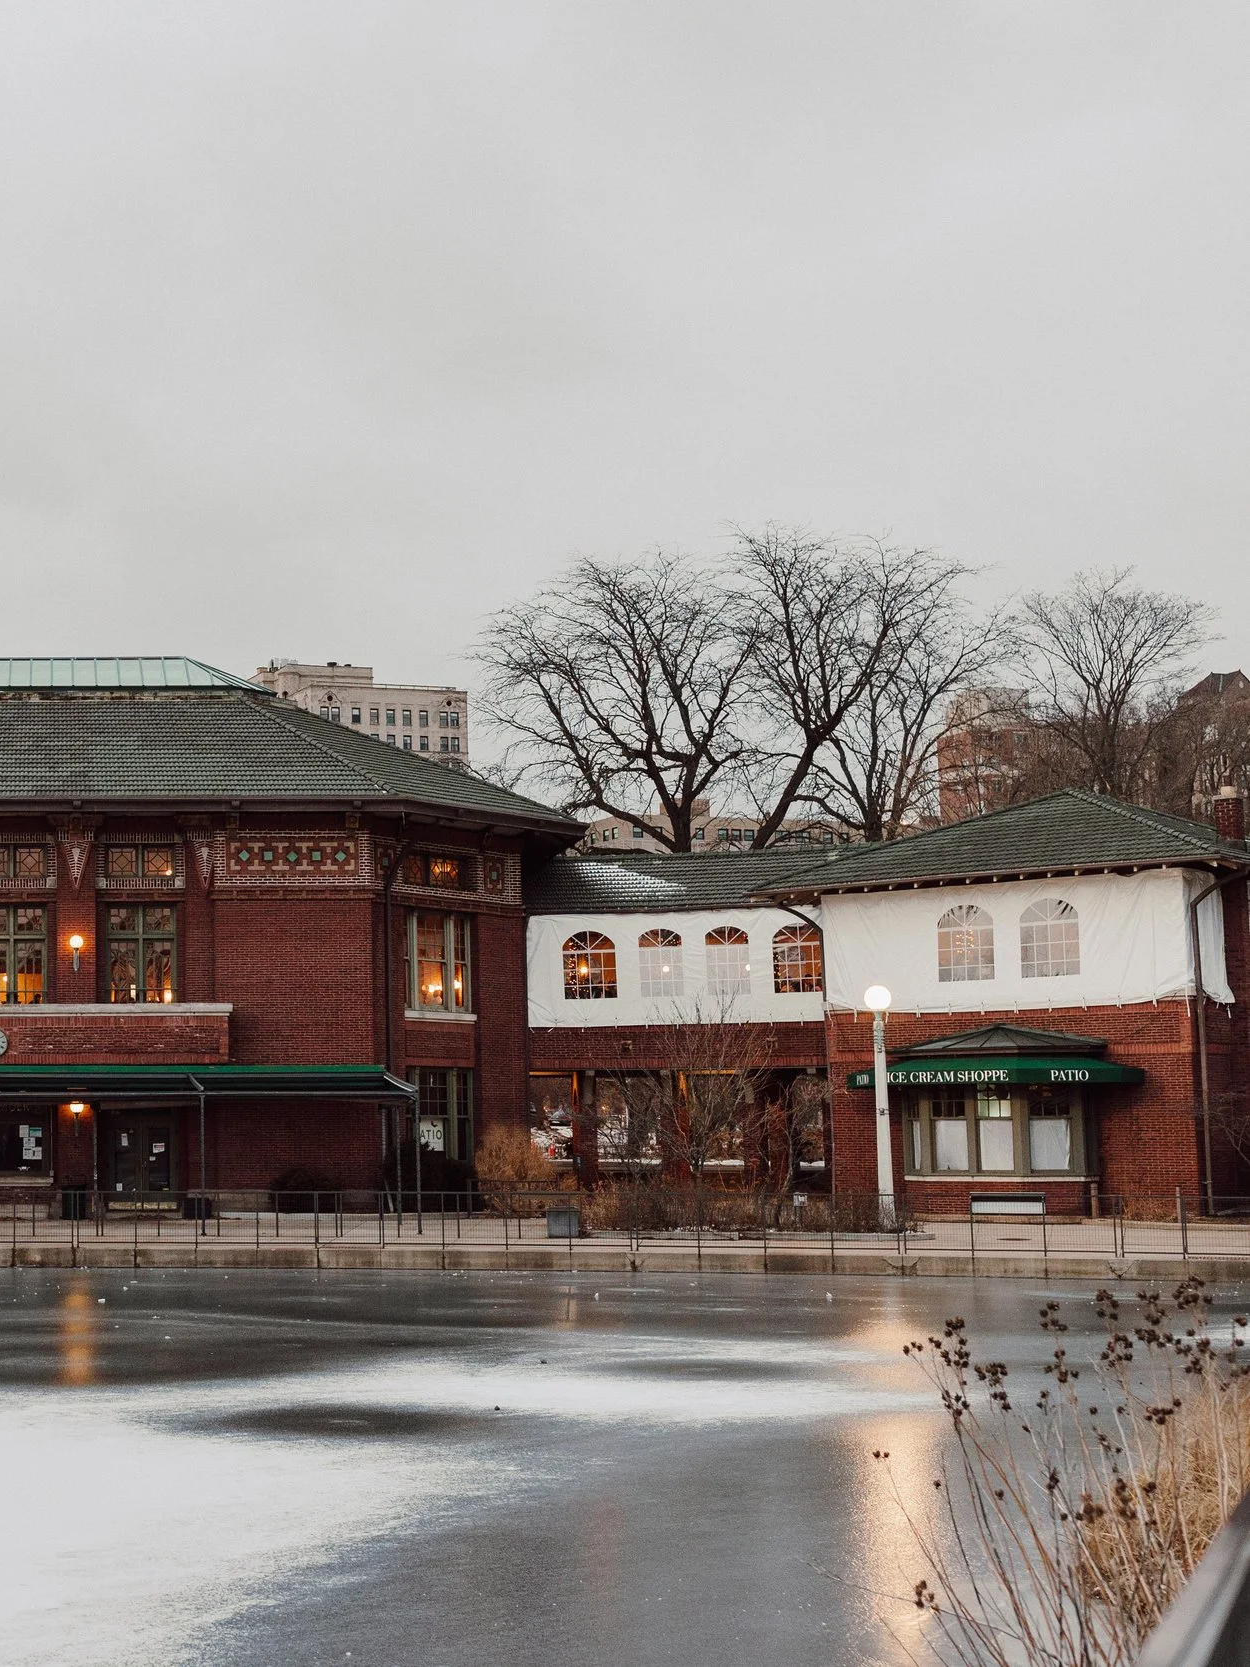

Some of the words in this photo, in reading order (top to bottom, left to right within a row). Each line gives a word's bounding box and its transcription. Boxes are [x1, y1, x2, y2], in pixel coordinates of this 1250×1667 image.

[856, 1074, 870, 1086] PATIO
[887, 1071, 907, 1083] ICE
[909, 1070, 954, 1083] CREAM
[957, 1069, 1009, 1082] SHOPPE
[1050, 1069, 1089, 1081] PATIO
[420, 1129, 442, 1140] ATIO
